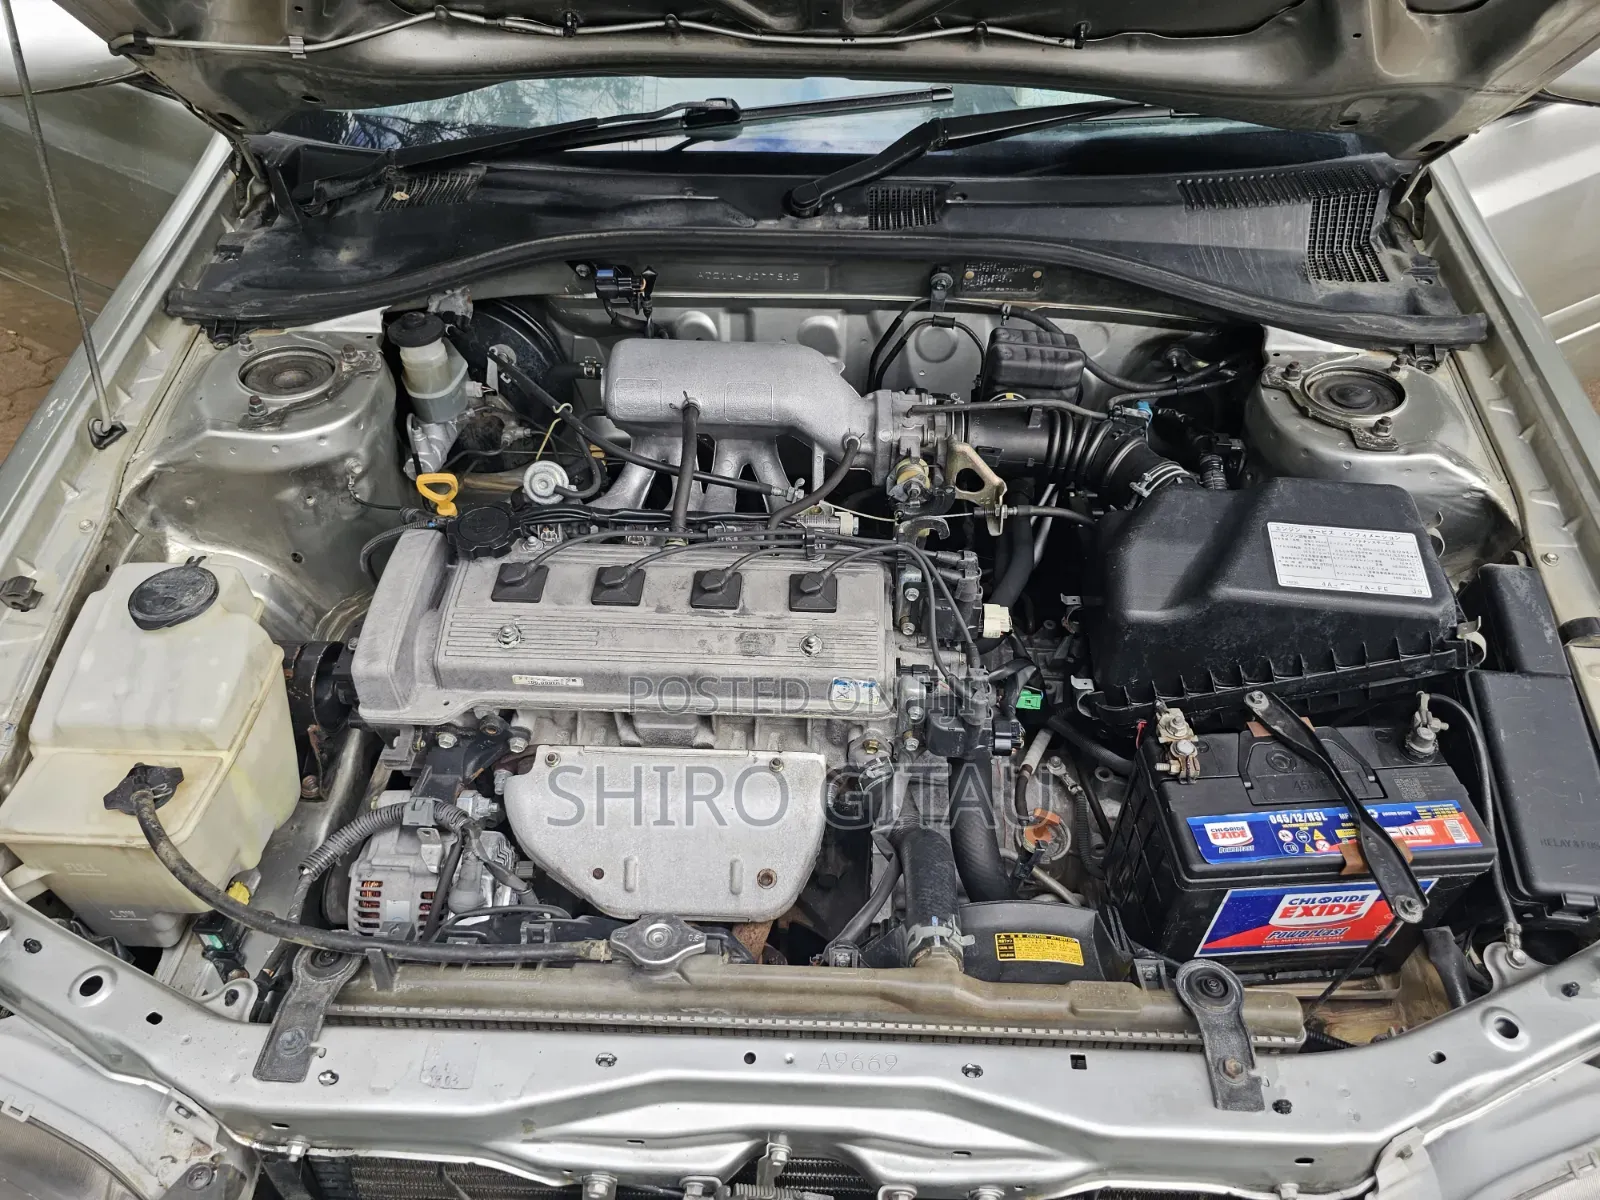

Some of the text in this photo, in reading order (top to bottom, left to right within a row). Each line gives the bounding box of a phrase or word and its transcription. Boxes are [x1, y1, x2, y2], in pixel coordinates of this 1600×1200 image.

[1211, 831, 1247, 840] EXIDE
[1288, 894, 1370, 906] CHLORIDE
[1279, 903, 1363, 919] EXIDE
[816, 1047, 898, 1073] A9669
